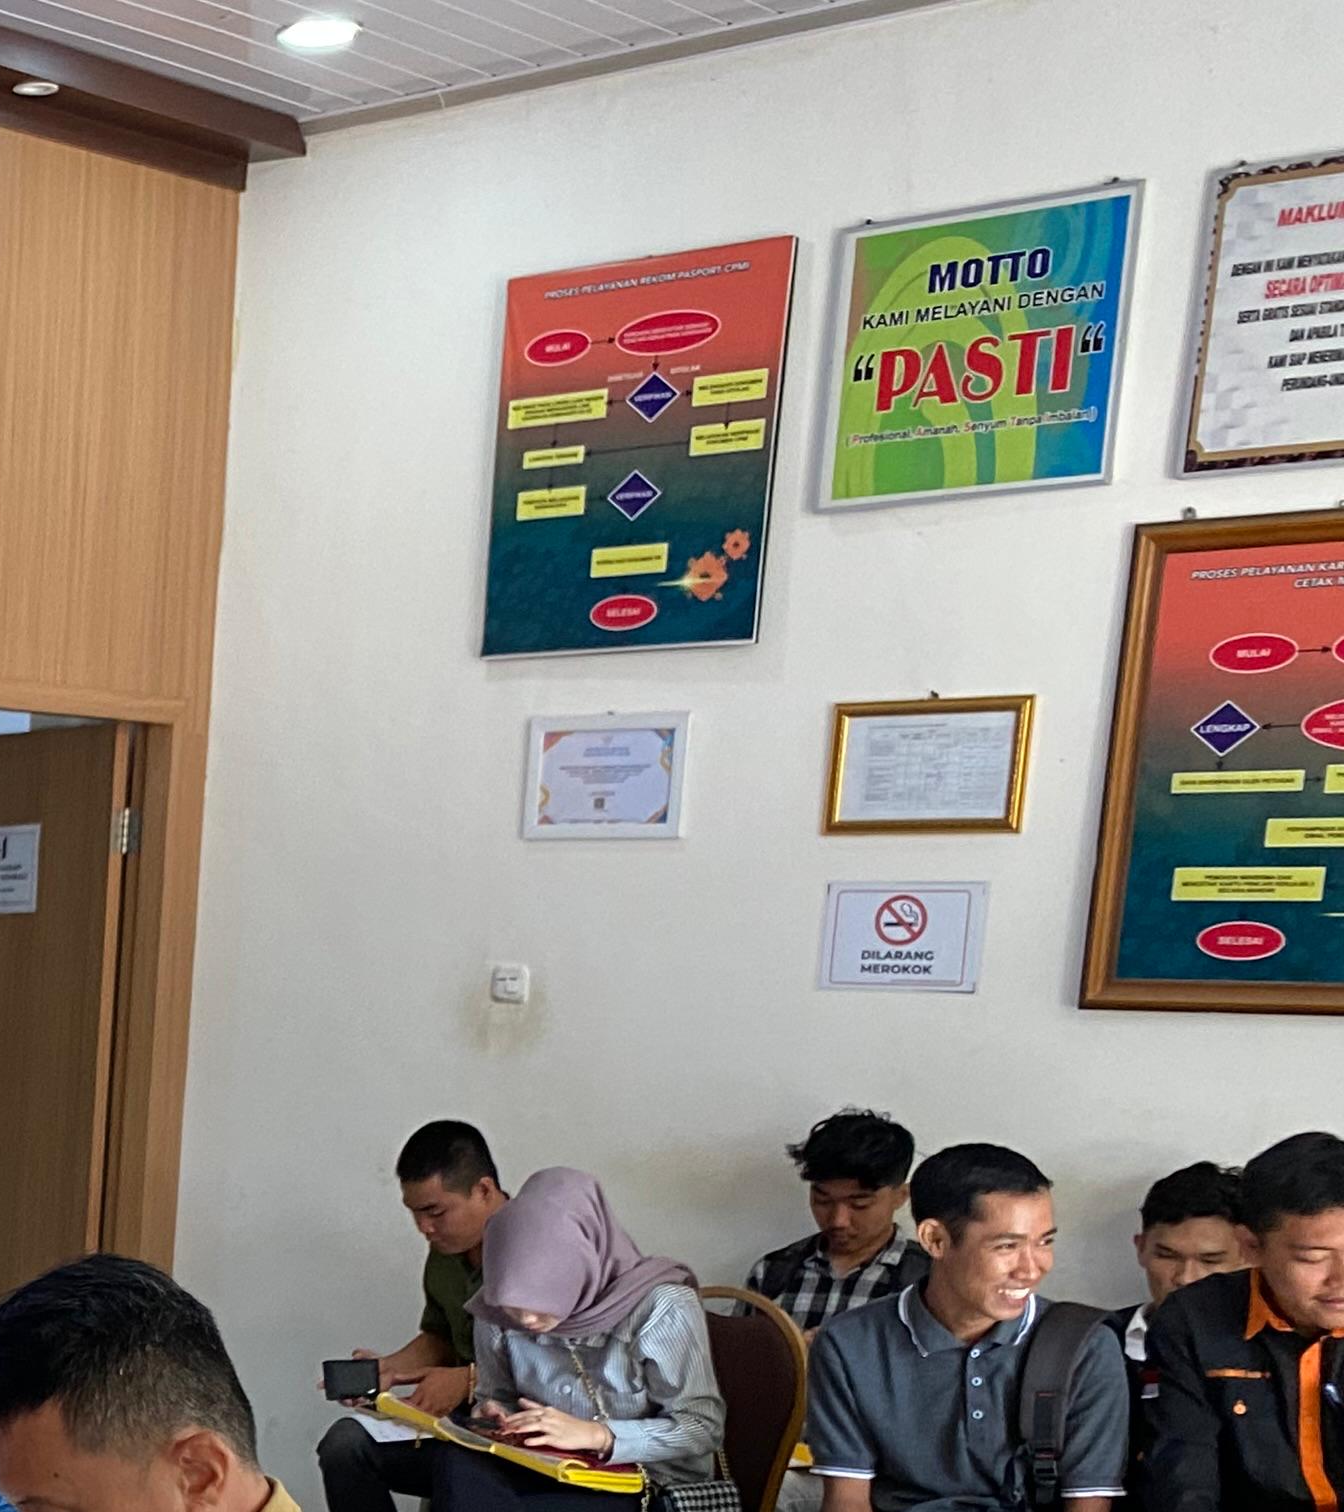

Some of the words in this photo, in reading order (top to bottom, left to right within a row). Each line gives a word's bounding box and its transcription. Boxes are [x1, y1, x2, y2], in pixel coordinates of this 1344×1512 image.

[928, 246, 1052, 294] MOTTO
[862, 310, 910, 331] KAMI
[914, 296, 1011, 323] MELAYANI
[1018, 282, 1105, 309] DENGAN
[964, 419, 1007, 433] Senyum
[1191, 567, 1238, 580] PROSES
[1239, 562, 1315, 577] PELAYANAN
[860, 950, 935, 961] DILARANG
[860, 963, 933, 975] MEROKOK
